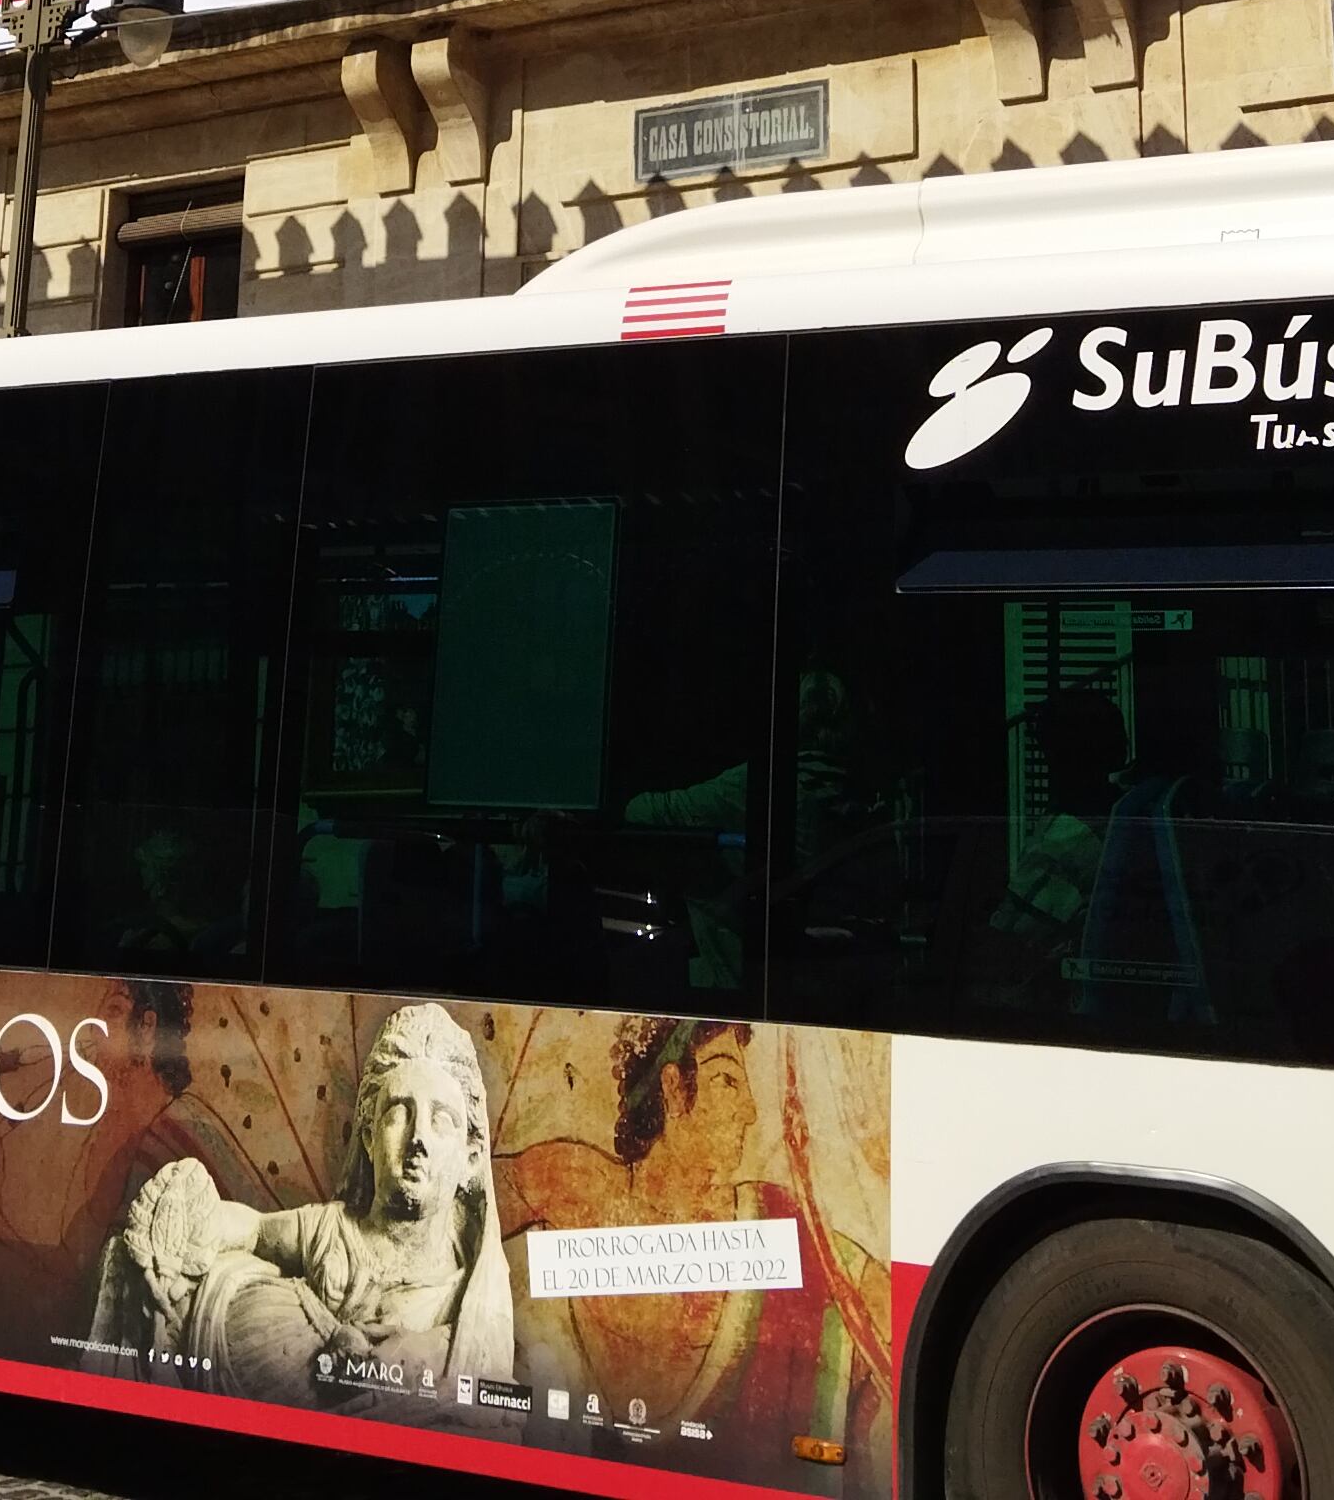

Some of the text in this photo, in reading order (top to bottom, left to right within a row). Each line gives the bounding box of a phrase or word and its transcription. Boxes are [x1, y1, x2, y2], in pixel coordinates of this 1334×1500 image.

[648, 122, 688, 162] CASA
[557, 1228, 766, 1259] PRORROGADA HASTA
[543, 1258, 788, 1291] EL 20 DE MARZO DE 2022
[346, 1359, 404, 1386] MARQ
[479, 1389, 531, 1411] Guarnacci
